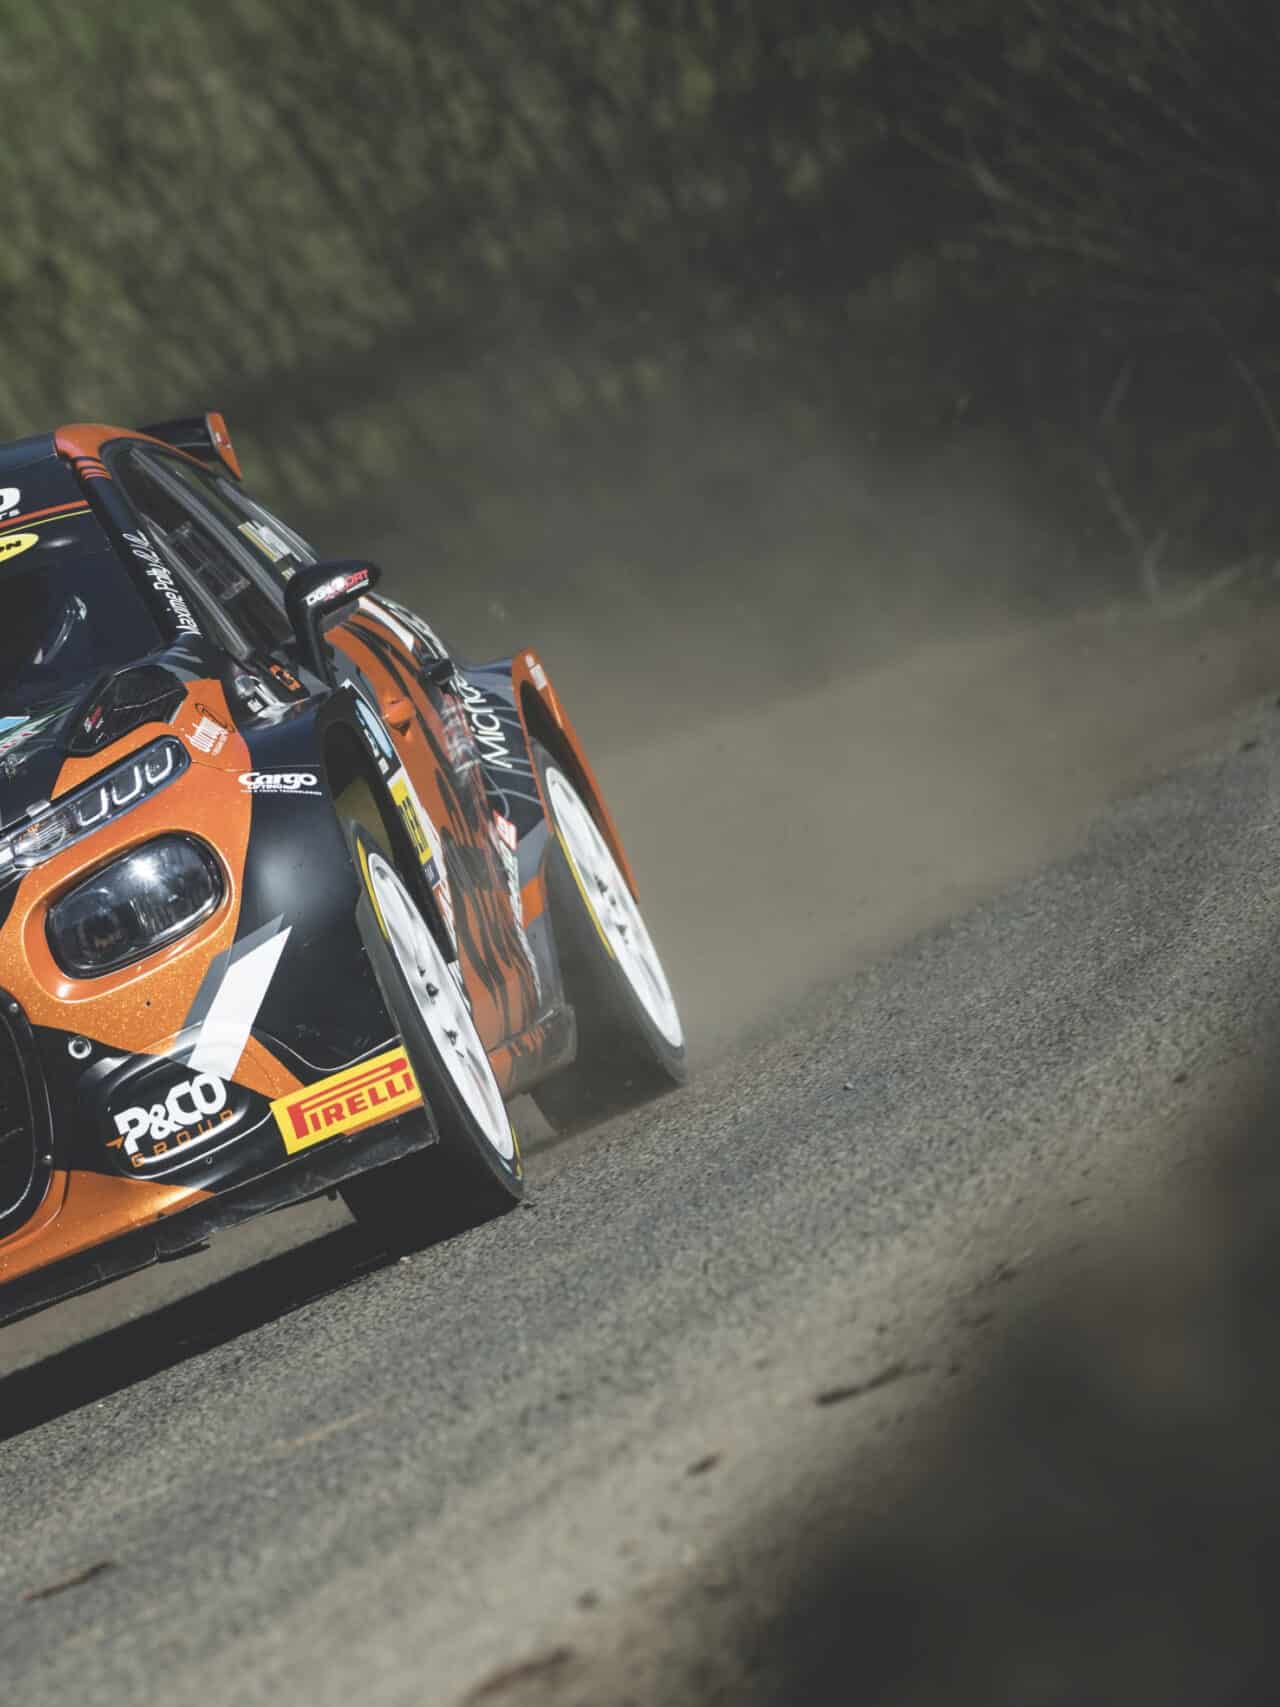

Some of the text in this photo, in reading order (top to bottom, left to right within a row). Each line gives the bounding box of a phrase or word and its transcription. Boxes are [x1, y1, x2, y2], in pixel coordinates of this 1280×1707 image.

[238, 772, 318, 790] Cargo
[114, 1071, 227, 1156] P&CO
[285, 1057, 416, 1140] PIRELLI
[131, 1108, 233, 1169] GROUP
